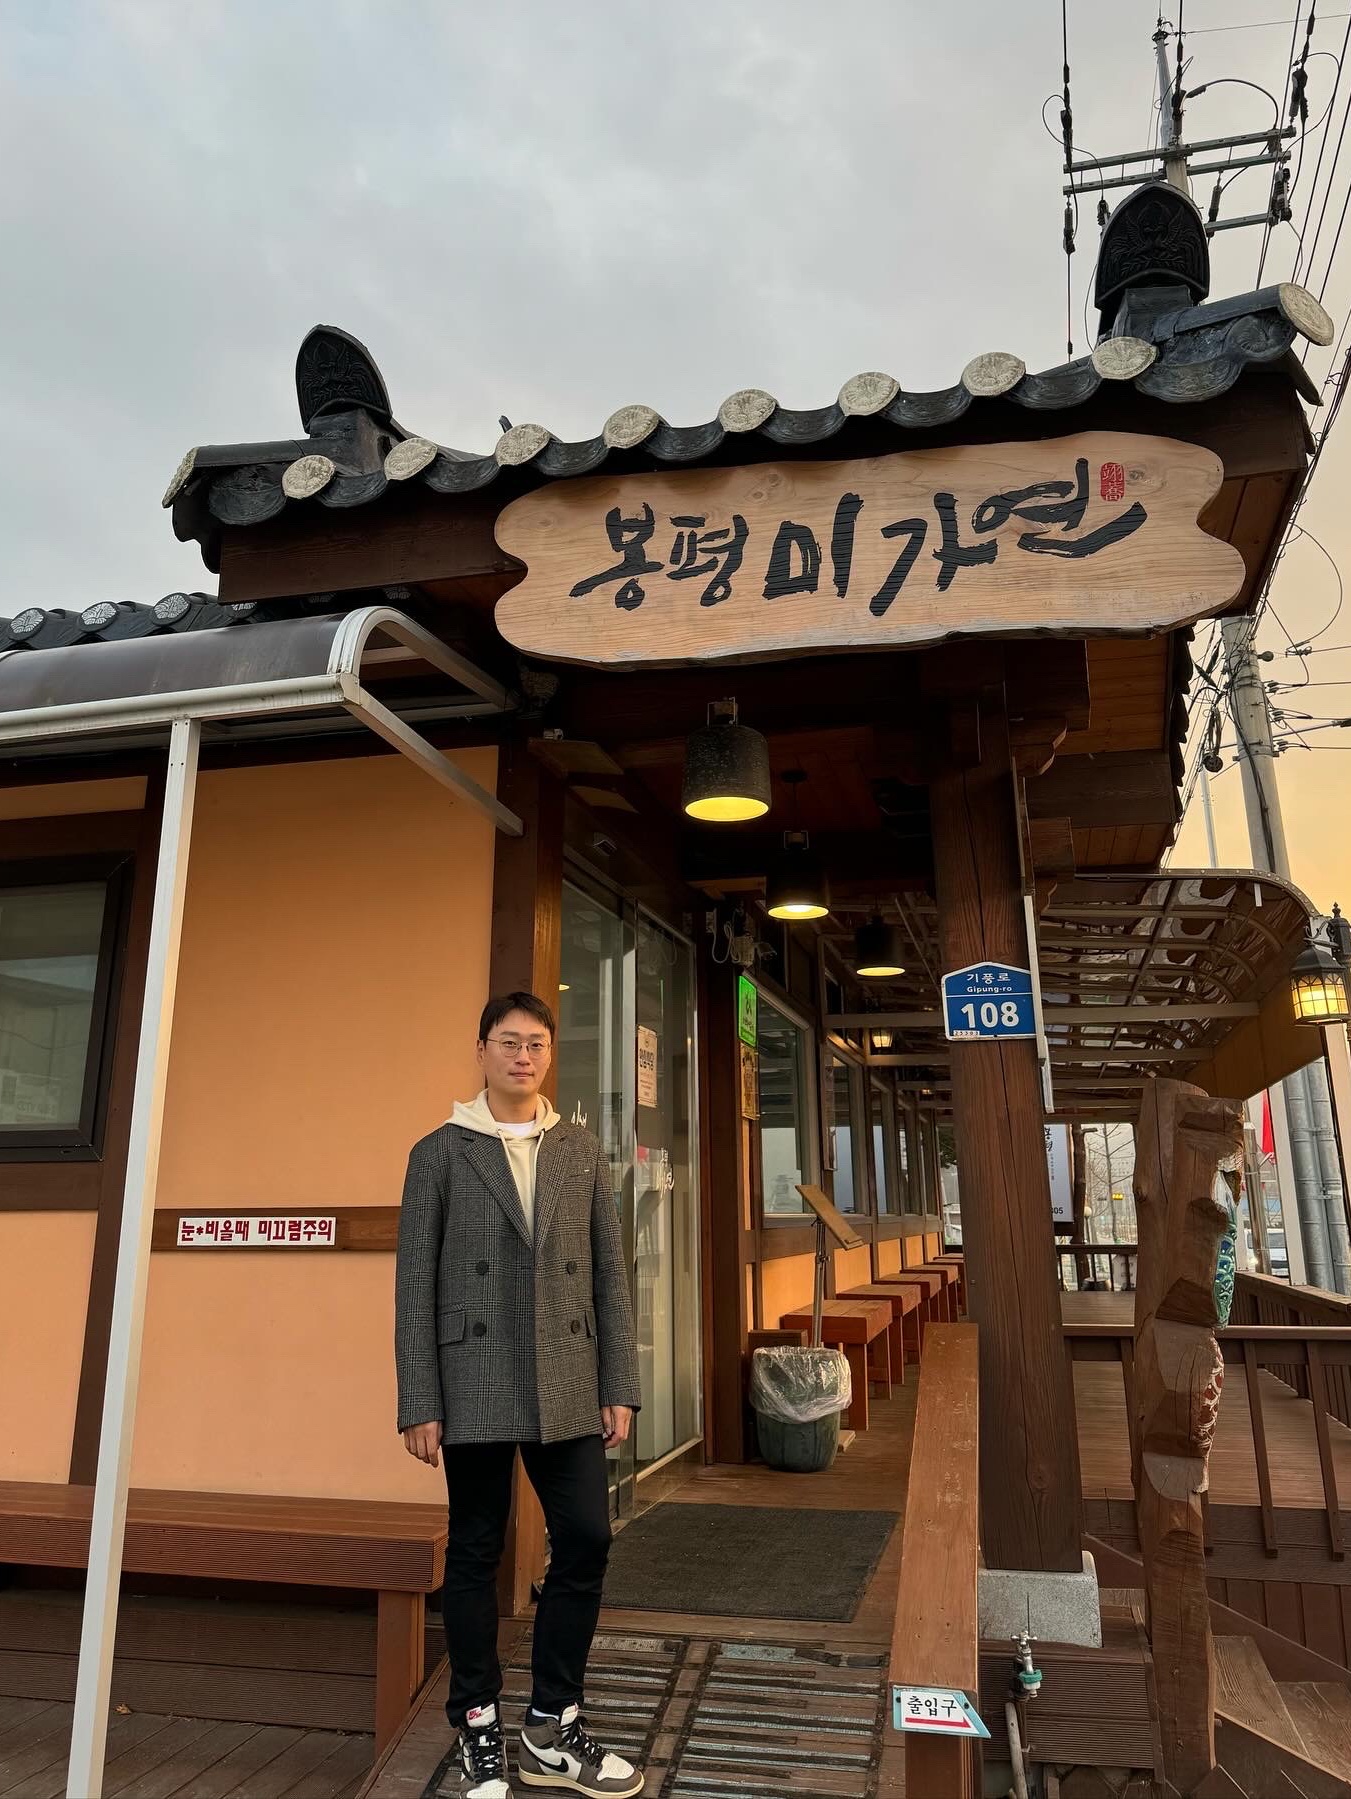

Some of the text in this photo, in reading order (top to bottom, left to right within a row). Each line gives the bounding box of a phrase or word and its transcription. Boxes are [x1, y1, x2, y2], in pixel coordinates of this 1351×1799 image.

[966, 972, 1011, 984] 기풍로
[966, 985, 1013, 994] Gipung-ro
[961, 1001, 1020, 1029] 108
[257, 1219, 333, 1242] 미끄럼주의
[907, 1695, 958, 1718] 출입구
